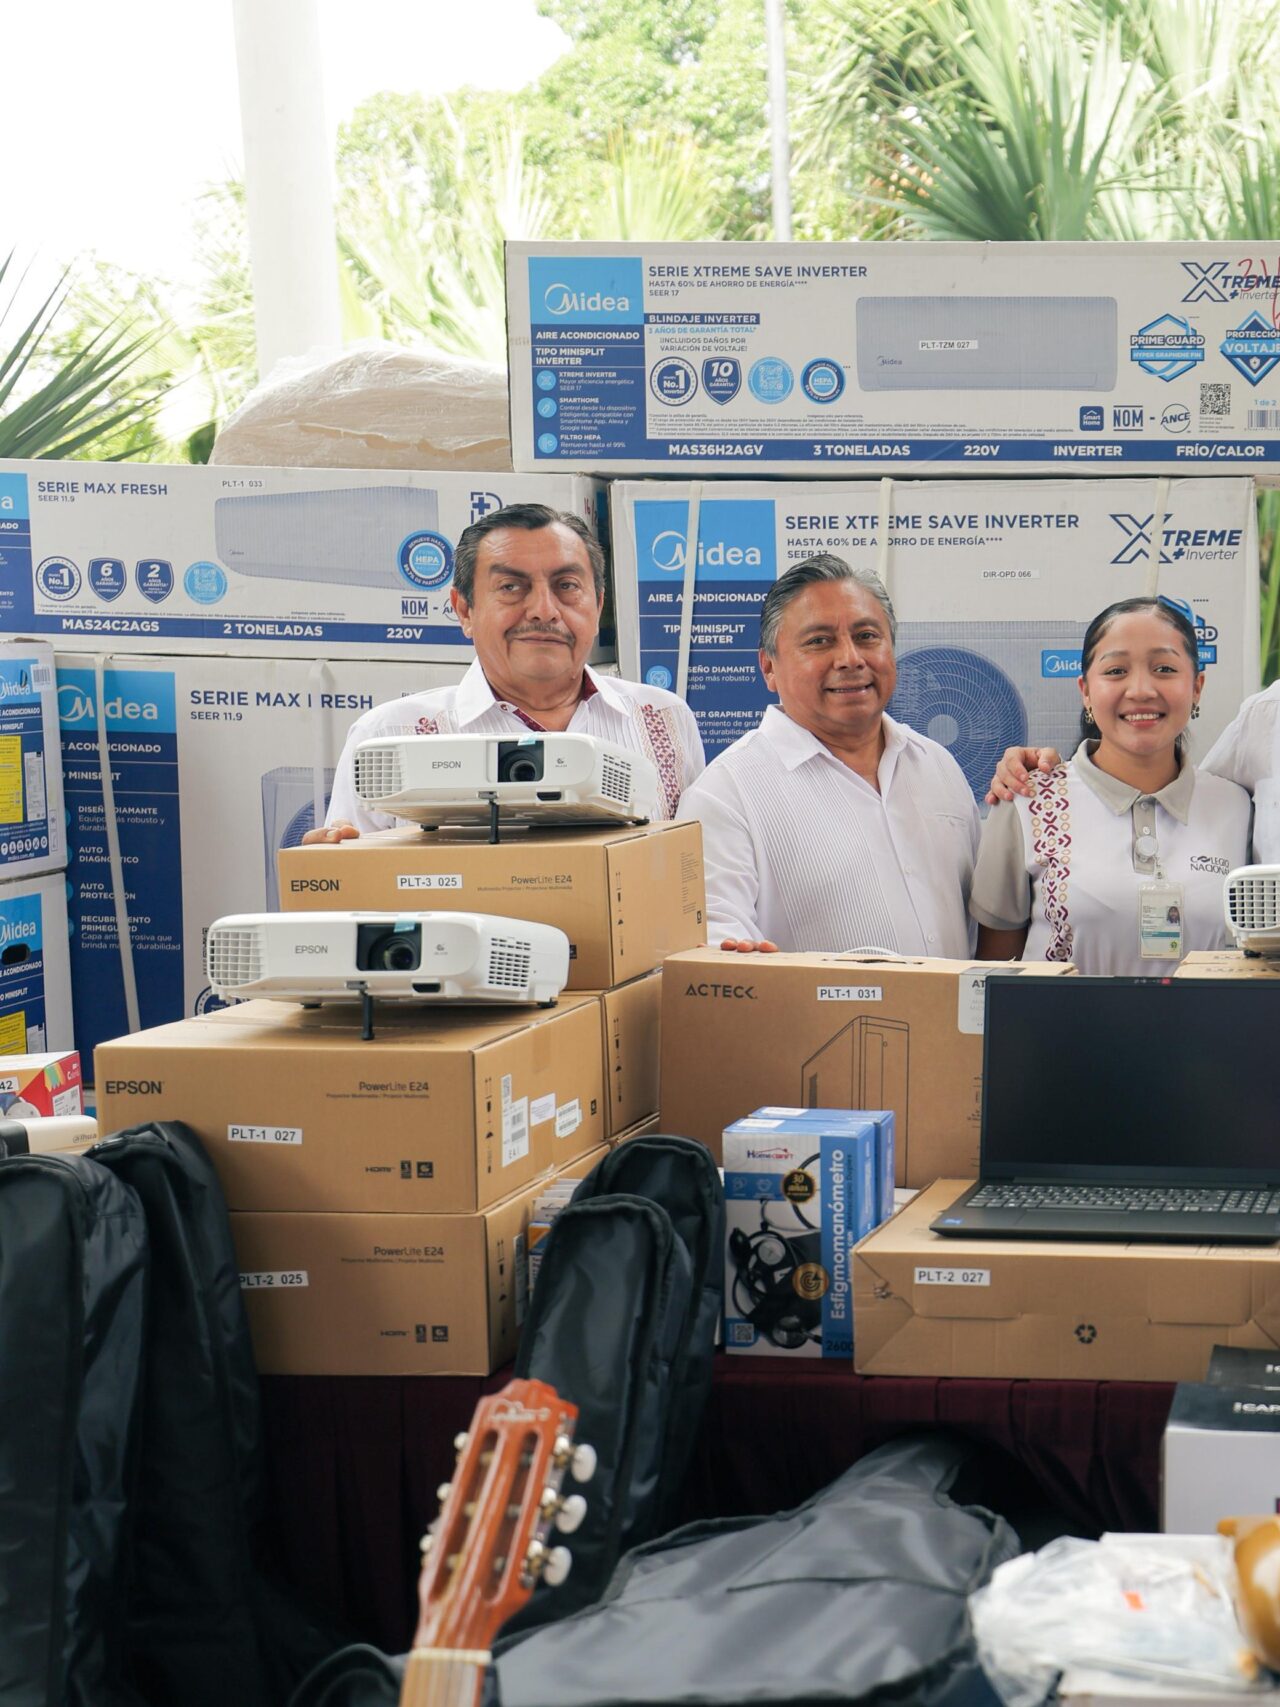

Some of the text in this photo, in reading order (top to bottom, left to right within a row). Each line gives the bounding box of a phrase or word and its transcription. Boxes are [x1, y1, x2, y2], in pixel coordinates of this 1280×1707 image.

[649, 266, 868, 277] SERIE XTREME SAVE INVERTER
[545, 283, 629, 315] Midea
[649, 314, 757, 323] BLINDAJE INVERTER
[536, 331, 640, 340] AIRE ACONDICIONADO
[689, 326, 728, 334] GARANTÍA
[703, 336, 729, 344] DAÑOS
[920, 341, 955, 349] PLT-TZM
[1131, 336, 1205, 345] PRIME GUARD
[536, 348, 606, 356] TIPO MINISPLIT
[659, 344, 700, 352] VARIACIÓN
[536, 357, 582, 365] INVERTER
[711, 362, 734, 376] 10
[1113, 409, 1143, 427] NOM
[1160, 411, 1191, 426] ANCE
[668, 443, 1265, 457] MAS36H2AGV 3 TONELADAS 220V INVERTER FRÍO/CALOR
[38, 481, 168, 495] SERIE MAX FRESH
[222, 480, 263, 488] PLT-1 033
[60, 495, 75, 503] 11.9
[785, 516, 839, 530] SERIE
[928, 515, 979, 529] SAVE
[985, 514, 1079, 529] INVERTER
[787, 538, 824, 546] HASTA
[826, 537, 850, 546] 60%
[852, 538, 867, 546] DE
[920, 538, 935, 546] DE
[415, 555, 440, 564] HEPA
[787, 550, 814, 559] SEER
[100, 562, 113, 577] 6
[147, 563, 161, 578] 2
[648, 593, 673, 602] AIRE
[402, 600, 428, 616] NOM
[62, 618, 423, 639] MAS24C2AGS 2 TONELADAS 220V
[692, 624, 745, 633] MINISPLIT
[705, 674, 720, 682] más
[58, 685, 158, 722] Mdea
[190, 690, 249, 706] SERIE
[256, 692, 301, 707] MAX
[190, 711, 243, 721] SEER 11.9
[431, 760, 462, 769] EPSON
[127, 816, 158, 824] robusto
[79, 846, 103, 854] AUTO
[399, 876, 458, 888] PLT-3 025
[511, 874, 573, 885] PowerLite E24
[291, 880, 340, 892] EPSON
[136, 942, 181, 951] durabilidad
[295, 944, 328, 954] EPSON
[685, 983, 755, 999] ACTECK
[820, 988, 877, 999] PLT-1 031
[105, 1081, 163, 1095] EPSON
[359, 1081, 430, 1092] PowerLite E24
[231, 1127, 296, 1142] PLT-1 027
[828, 1149, 848, 1319] Esfigmomanómetro
[373, 1246, 444, 1256] PowerLite E24
[281, 1274, 303, 1285] 025
[918, 1270, 984, 1284] PLT-2 027
